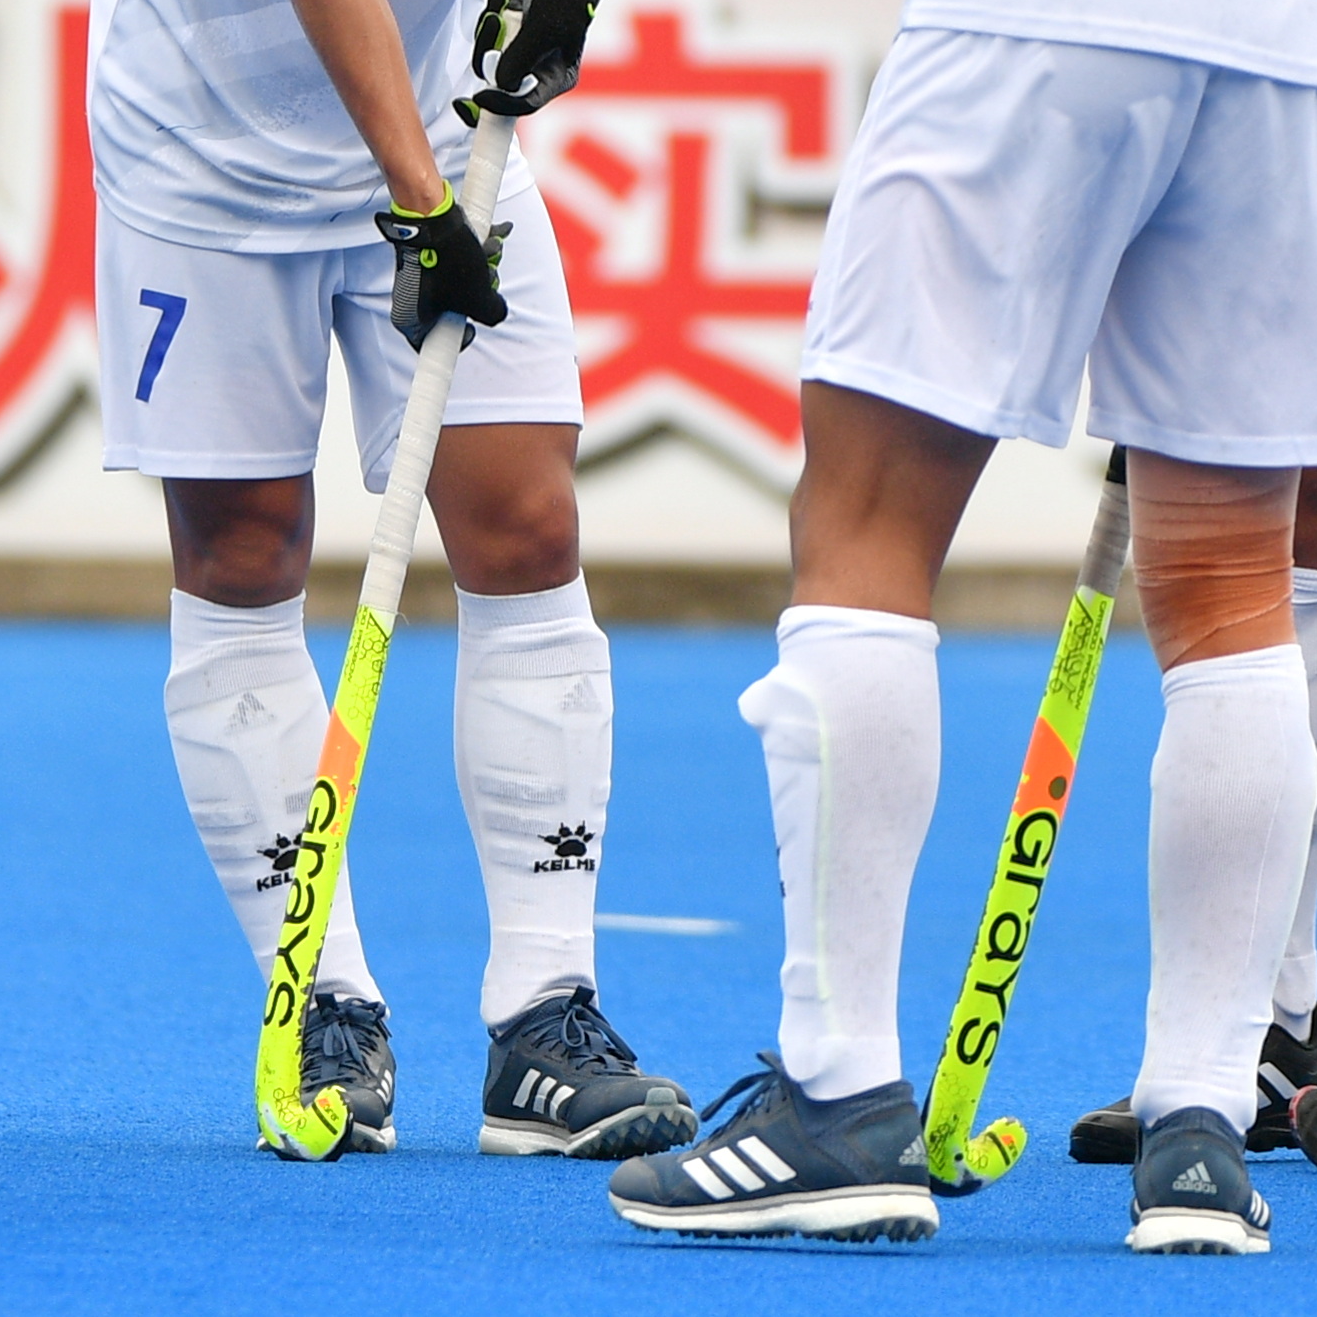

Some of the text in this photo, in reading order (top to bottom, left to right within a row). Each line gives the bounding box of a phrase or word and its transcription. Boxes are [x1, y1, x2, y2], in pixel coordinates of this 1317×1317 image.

[134, 288, 188, 403] 7
[534, 858, 596, 874] KELME
[1172, 1180, 1218, 1195] adidas
